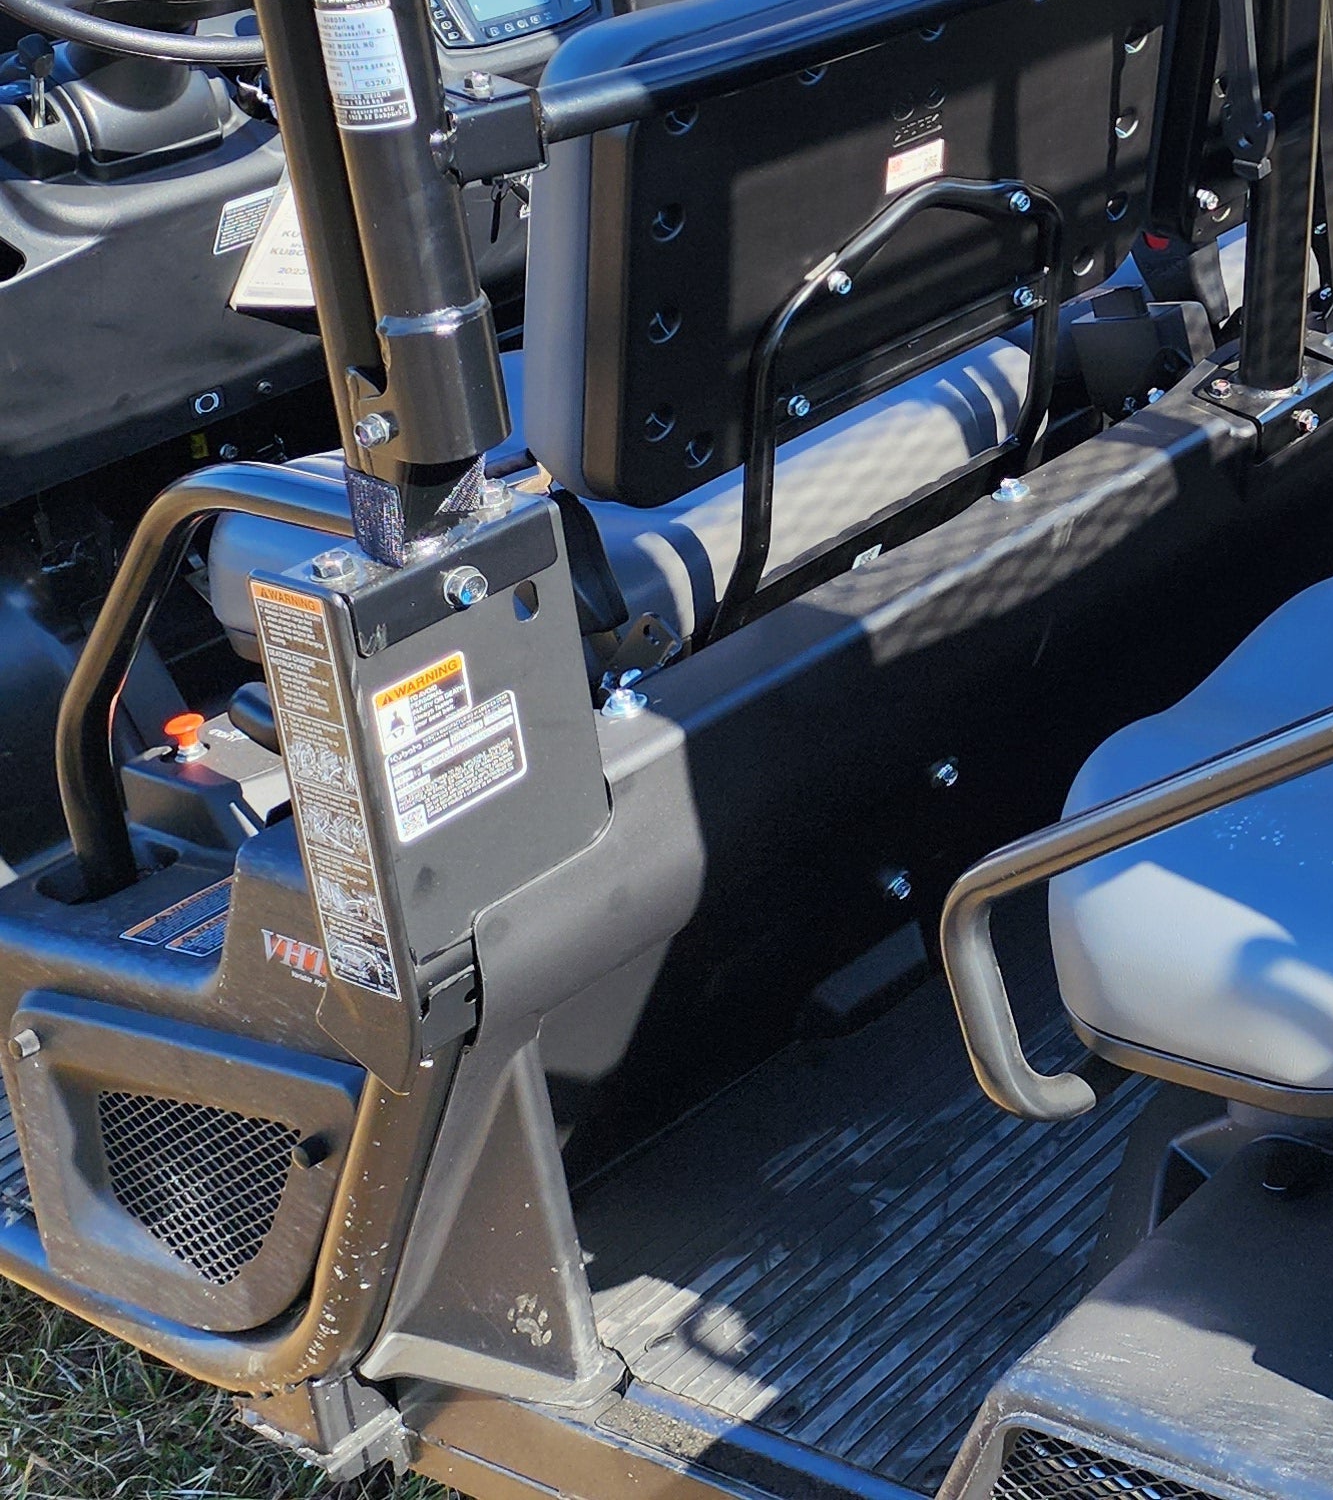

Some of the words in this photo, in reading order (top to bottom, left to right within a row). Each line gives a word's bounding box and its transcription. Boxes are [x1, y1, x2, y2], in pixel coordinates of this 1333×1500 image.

[268, 588, 316, 611] WARNING
[394, 659, 458, 699] WARNING
[410, 694, 418, 702] TO
[418, 684, 437, 698] AVOID
[411, 689, 444, 709] PERSONAL
[434, 695, 444, 705] OR
[389, 742, 423, 764] Kubota
